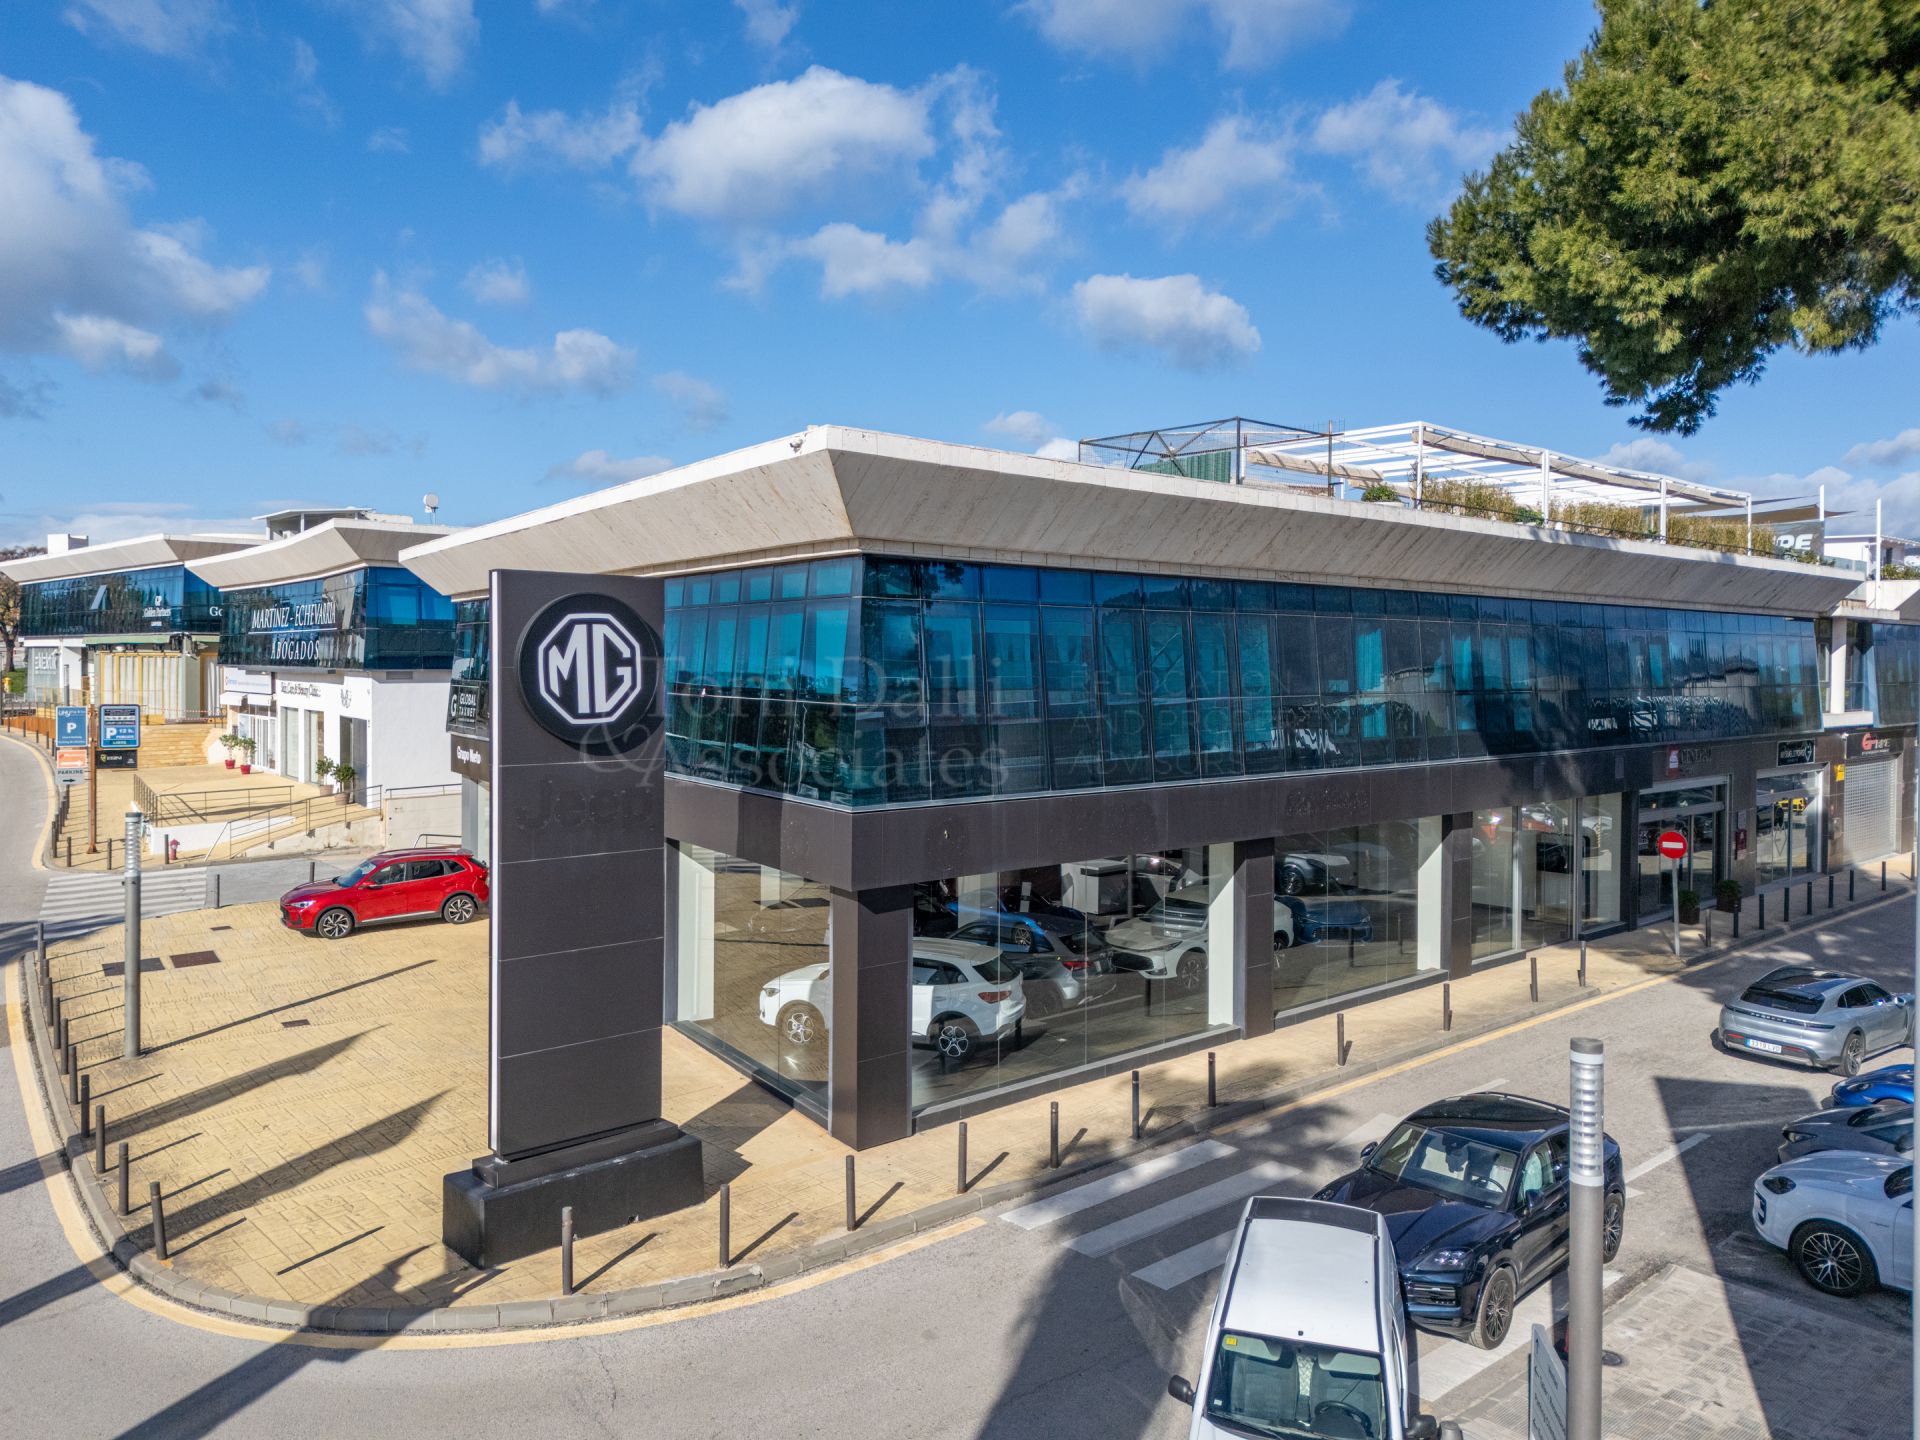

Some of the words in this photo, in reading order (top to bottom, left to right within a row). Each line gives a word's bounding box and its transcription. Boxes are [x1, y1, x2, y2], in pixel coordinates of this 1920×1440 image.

[251, 603, 290, 629] MARTÍNEZ
[271, 640, 320, 660] ABOGADOS
[549, 624, 632, 714] MG
[460, 694, 476, 706] GLOBAL
